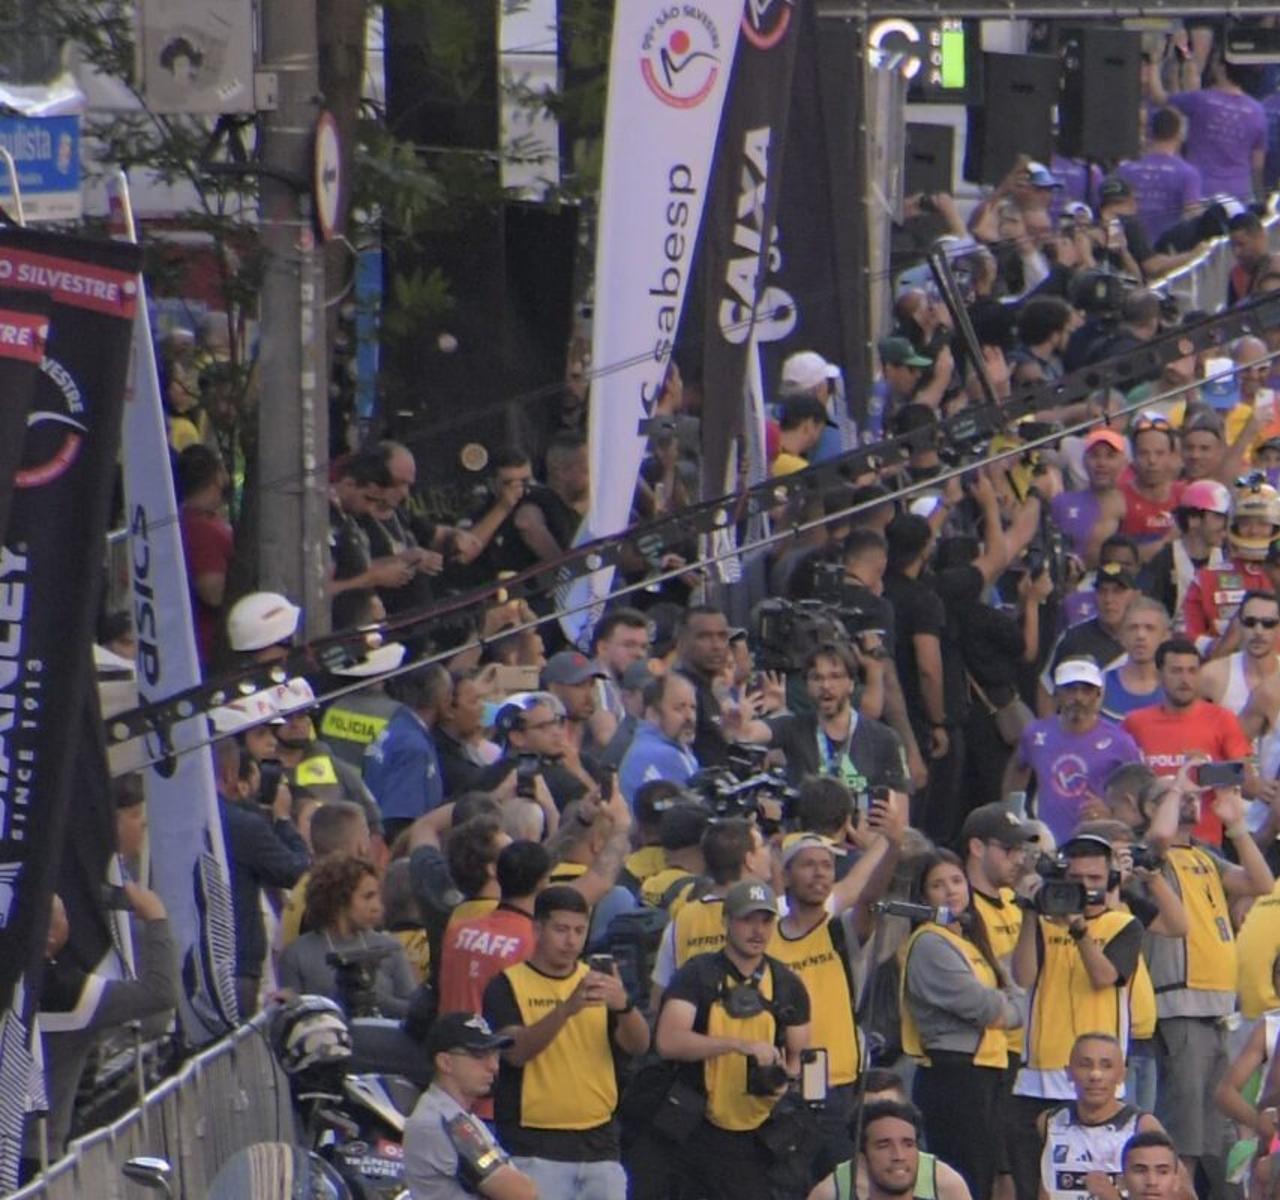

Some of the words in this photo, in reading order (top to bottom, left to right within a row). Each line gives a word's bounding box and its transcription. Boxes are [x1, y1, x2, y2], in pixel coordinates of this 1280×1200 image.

[650, 162, 698, 364] sabesp
[17, 264, 121, 302] SILVESTRE
[454, 927, 521, 958] STAFF
